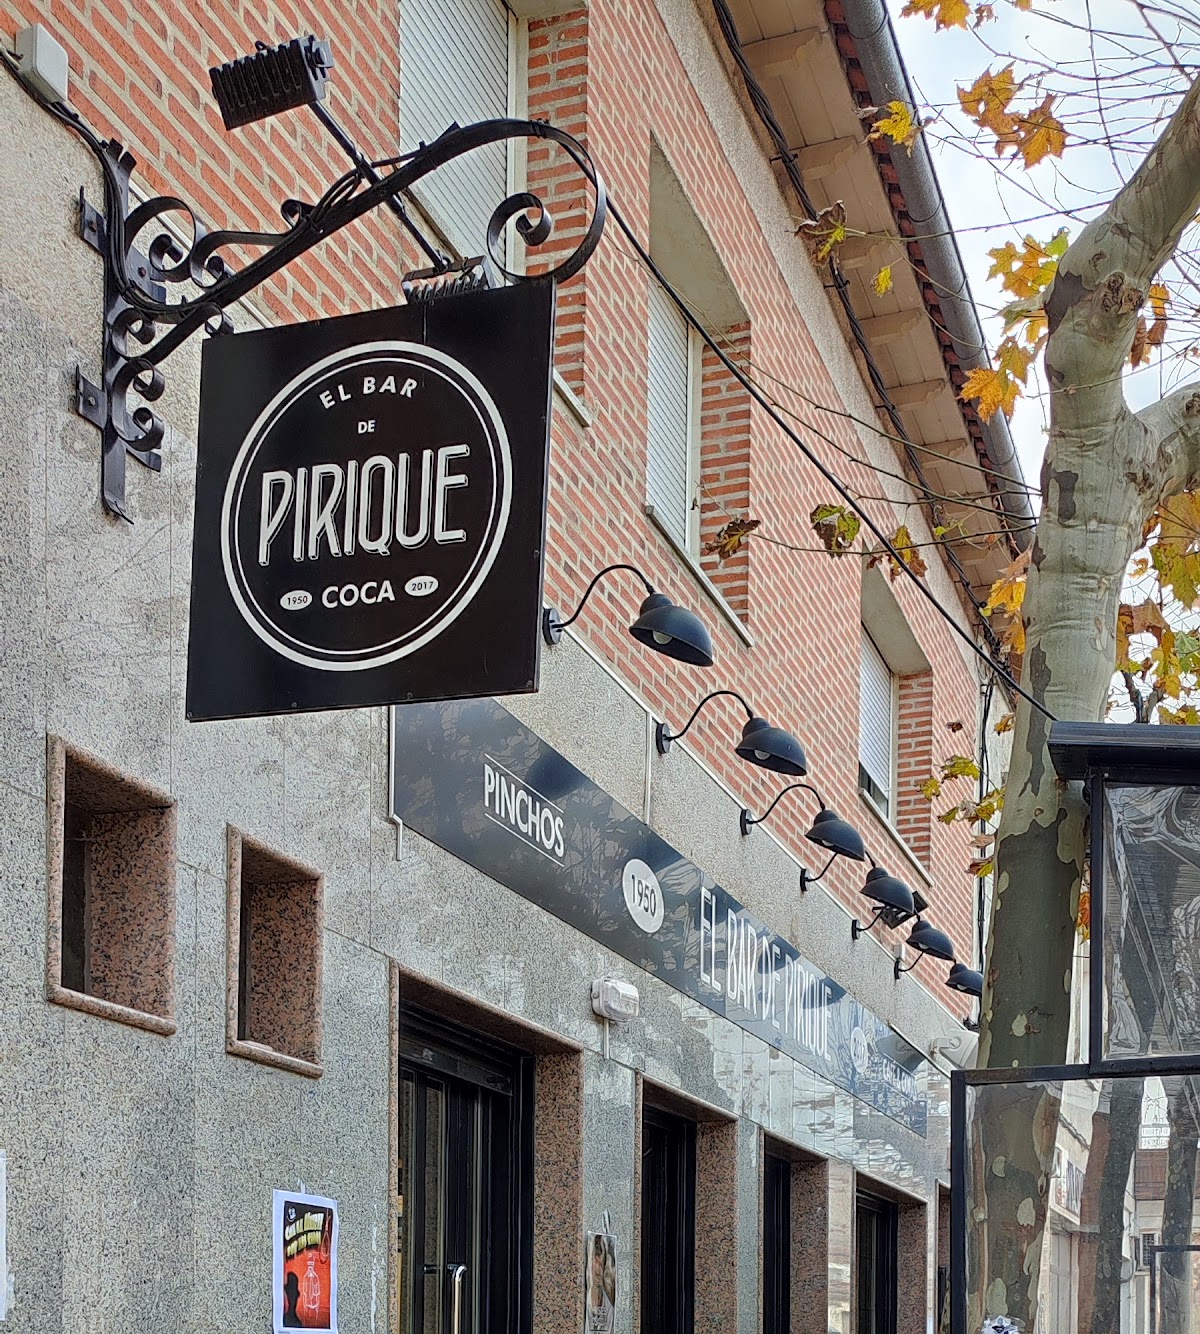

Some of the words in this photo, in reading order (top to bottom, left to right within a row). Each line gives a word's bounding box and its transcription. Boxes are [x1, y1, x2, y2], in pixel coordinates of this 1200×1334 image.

[319, 382, 352, 410] EL
[362, 375, 419, 399] BAR
[357, 419, 376, 434] DE
[257, 443, 471, 567] PIRIQUE
[286, 594, 308, 607] 1950
[321, 579, 396, 609] COCA
[411, 579, 434, 592] 2017
[484, 763, 565, 858] PINCHOS
[631, 873, 657, 918] 1950
[701, 886, 722, 992] EL
[727, 907, 758, 1019] BAR
[762, 935, 781, 1030] DE
[784, 953, 832, 1062] PIRIQUE
